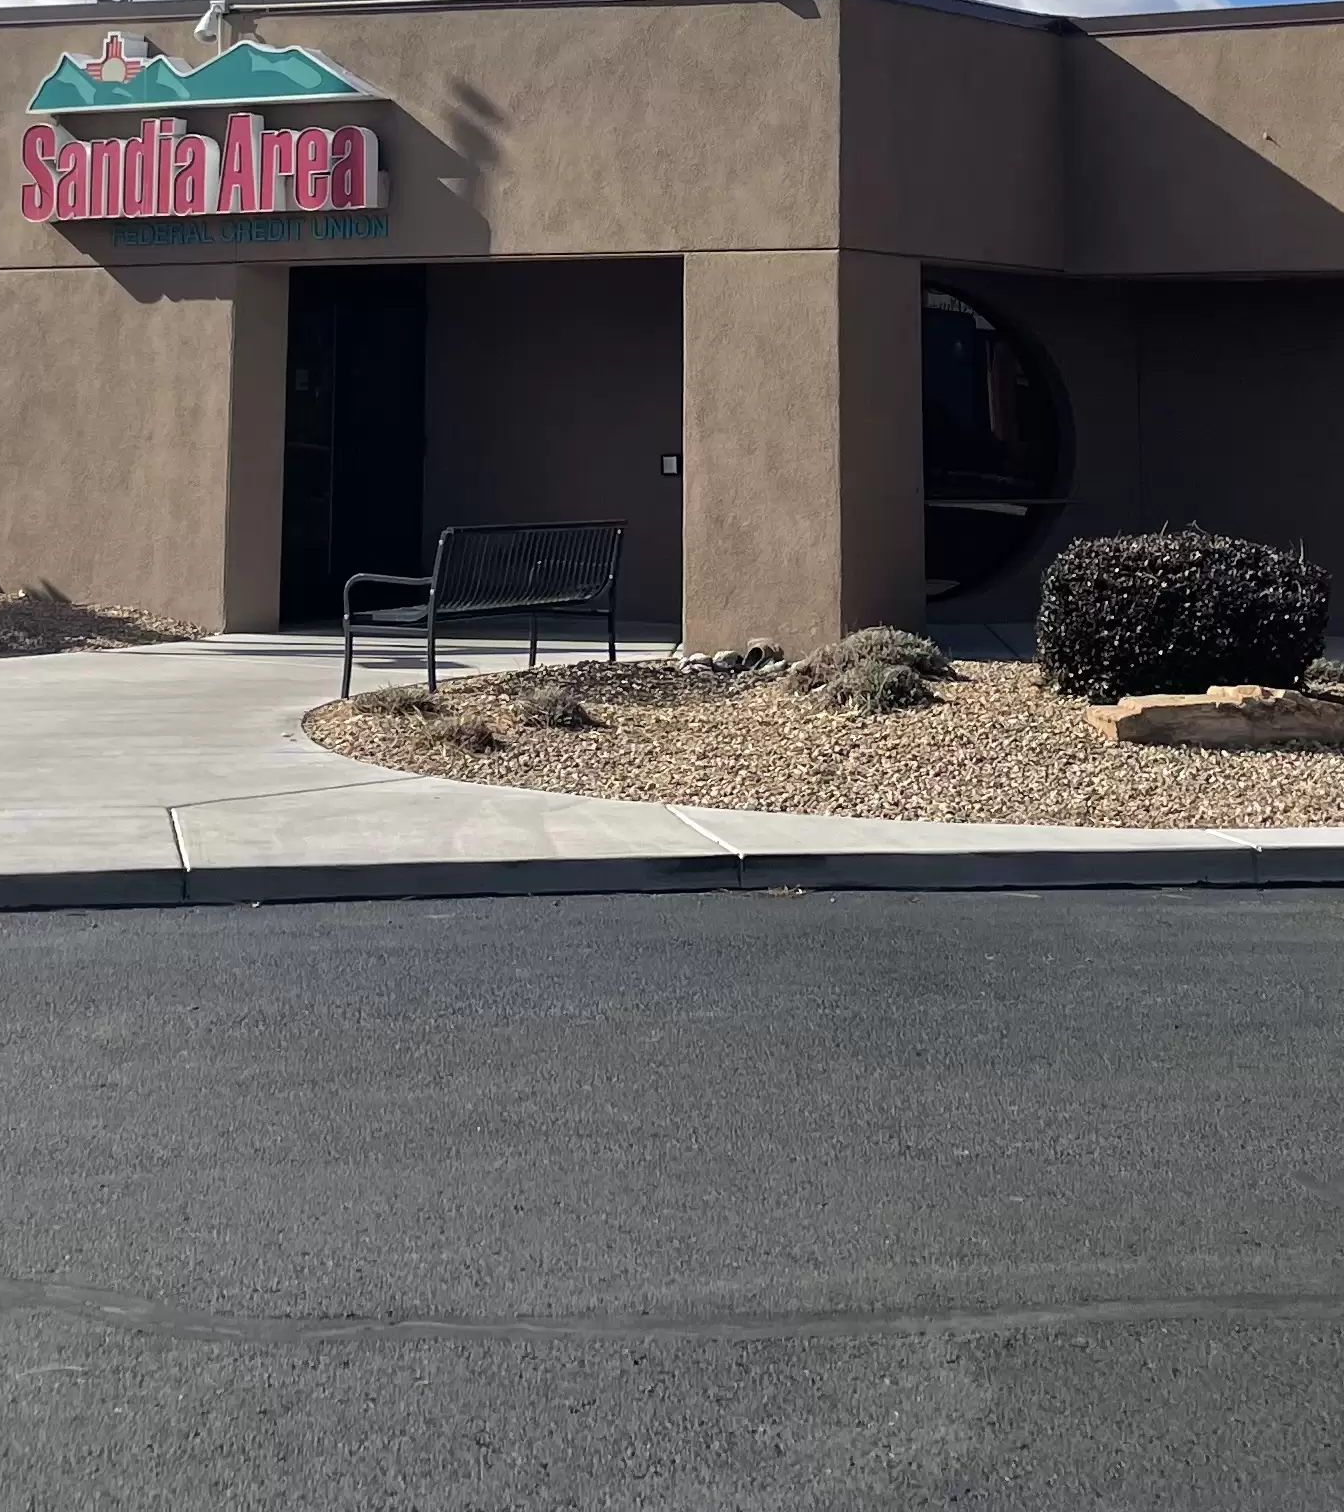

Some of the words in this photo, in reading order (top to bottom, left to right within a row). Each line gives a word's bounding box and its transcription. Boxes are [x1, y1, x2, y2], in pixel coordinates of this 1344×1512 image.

[21, 118, 209, 223] Sandia
[217, 113, 369, 214] Area
[111, 220, 214, 246] FEDERAL
[219, 216, 306, 244] CREDIT
[311, 214, 389, 240] UNION
